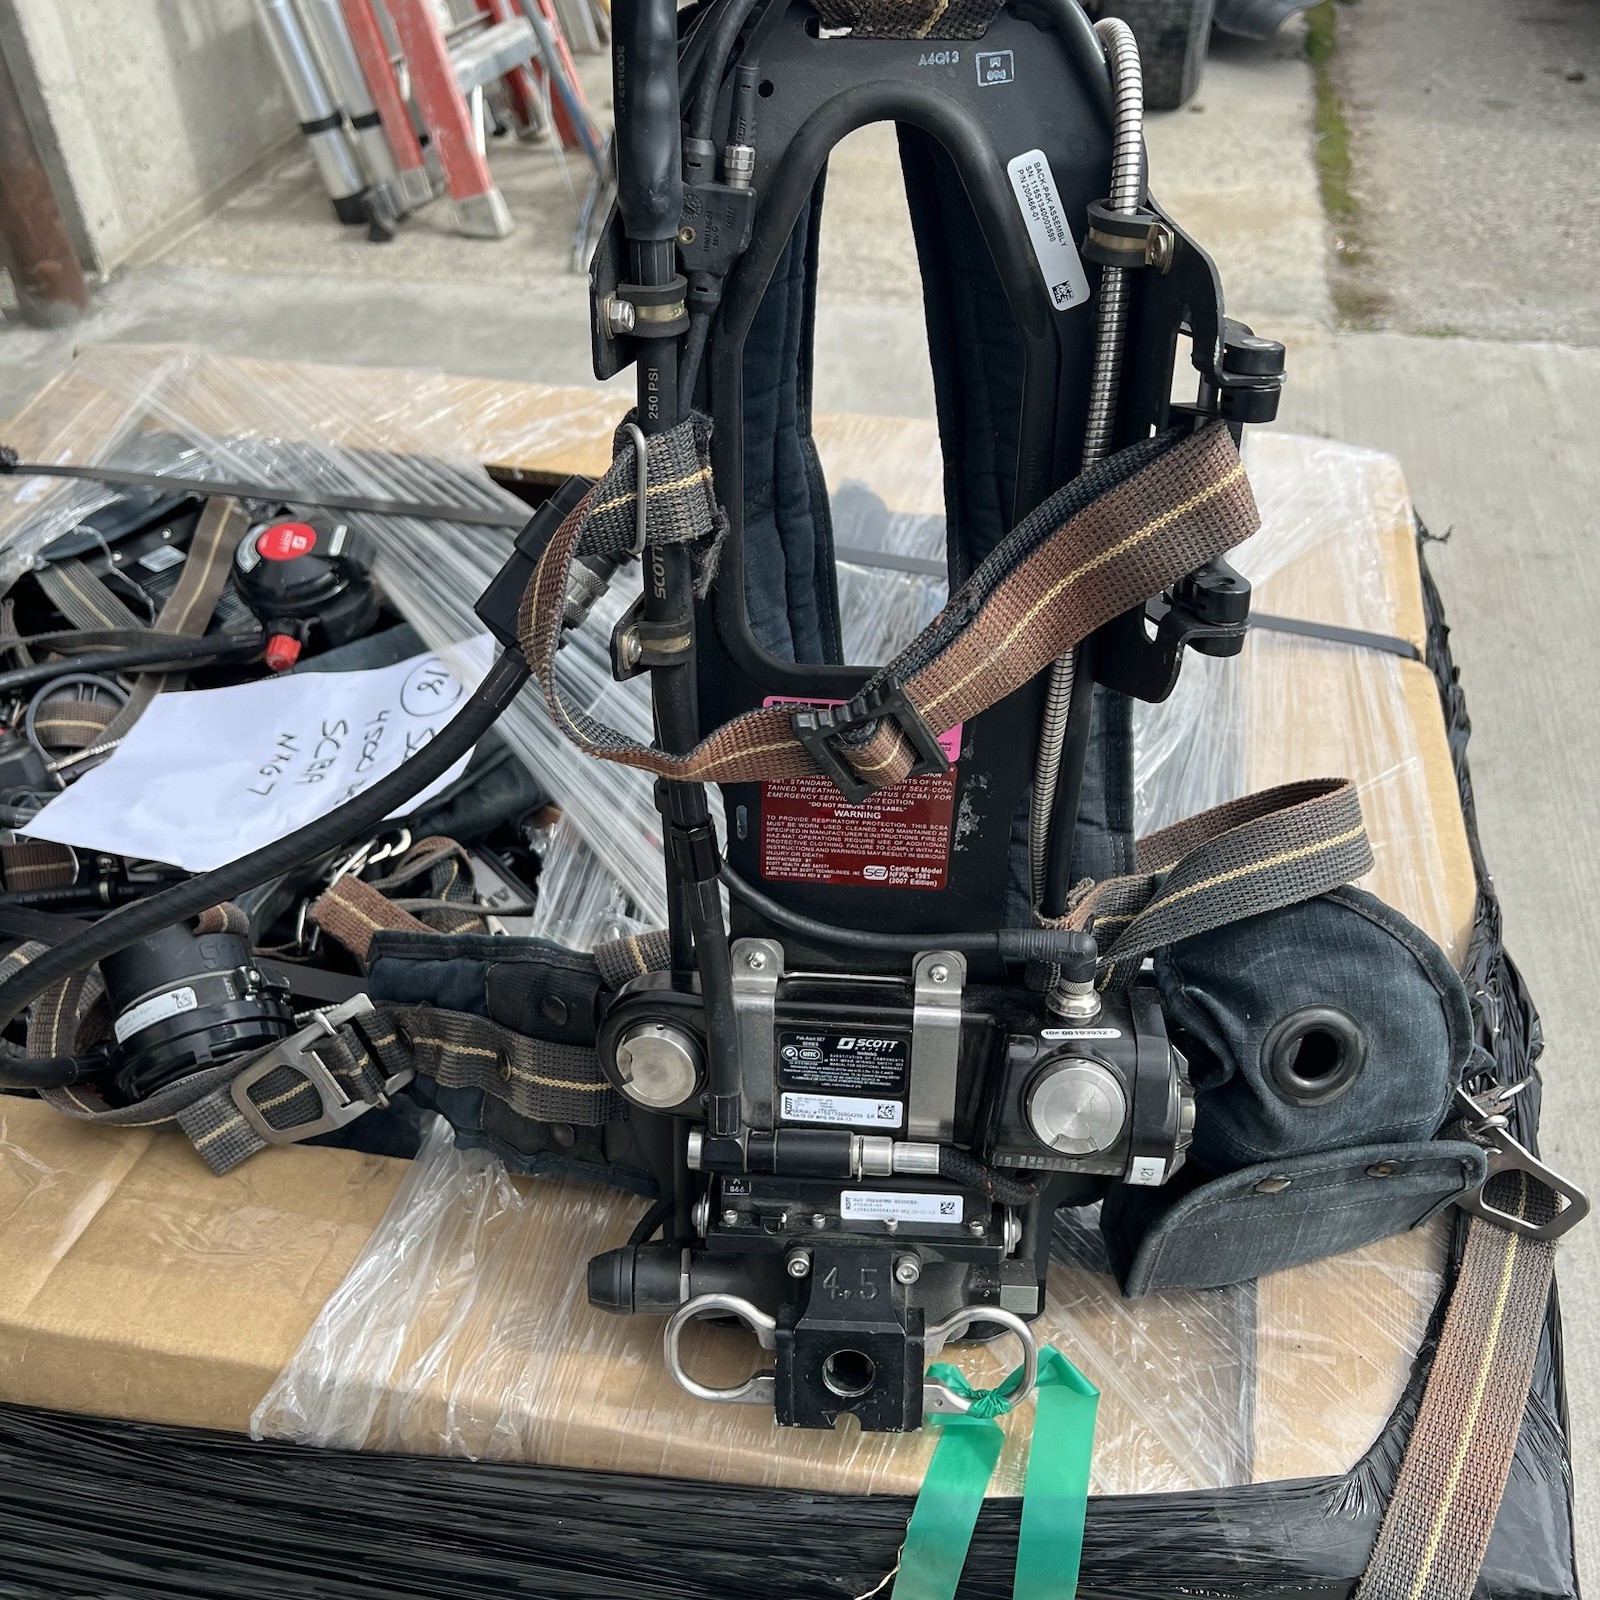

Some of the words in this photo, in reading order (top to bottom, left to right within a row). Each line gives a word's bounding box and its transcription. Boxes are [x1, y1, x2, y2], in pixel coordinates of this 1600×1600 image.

[1016, 168, 1026, 183] P/N
[1032, 161, 1053, 203] BACK-PAK
[1047, 204, 1068, 247] ASSEMBLY
[648, 367, 658, 390] PSI
[648, 395, 658, 419] 250
[652, 545, 665, 599] SCOTT
[790, 778, 832, 786] STANDARD
[909, 785, 951, 793] SELF-CON-
[766, 791, 818, 799] EMERGENCY
[811, 817, 859, 825] RESPIRATORY
[833, 810, 881, 819] WARNING
[909, 879, 937, 887] Edition)
[856, 1038, 898, 1048] SCOTT
[784, 1097, 792, 1114] SCOTT
